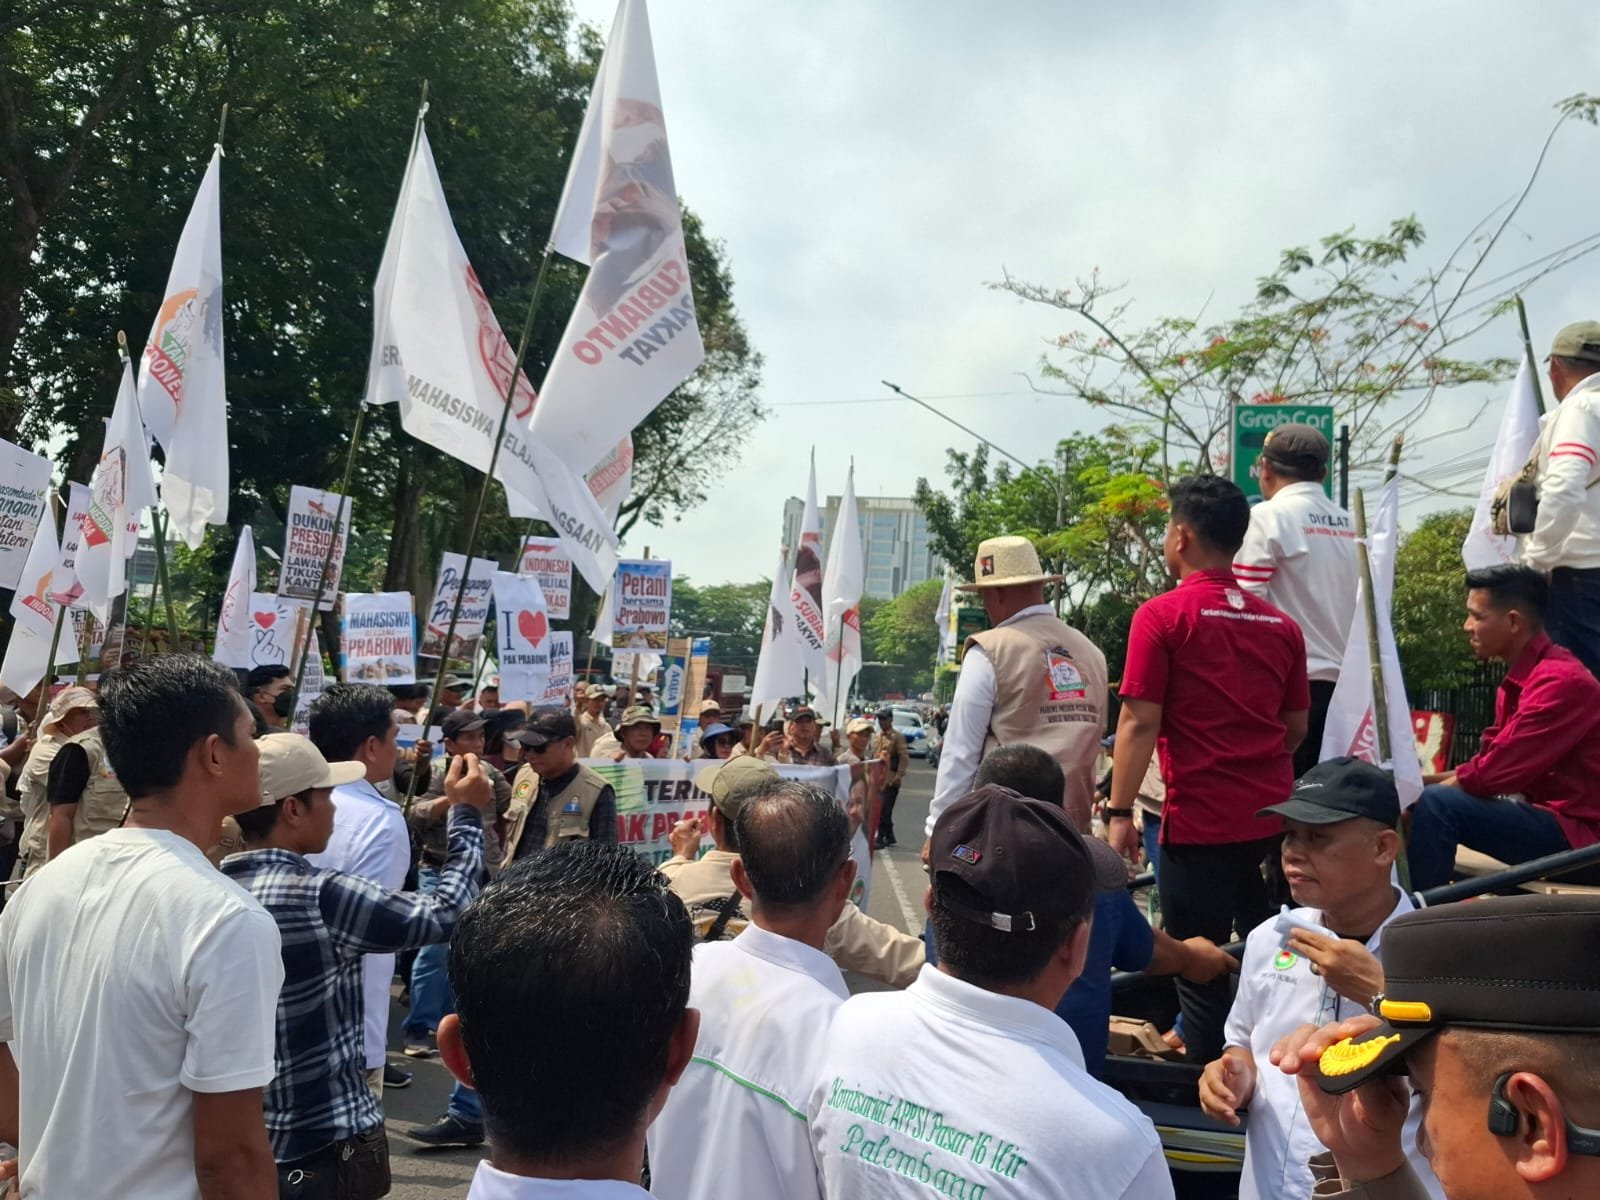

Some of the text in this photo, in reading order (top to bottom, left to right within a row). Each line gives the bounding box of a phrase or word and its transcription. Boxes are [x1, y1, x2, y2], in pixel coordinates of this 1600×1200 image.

[407, 375, 495, 437] MAHASISWA
[1239, 409, 1330, 428] GrabCar
[293, 513, 345, 534] DUKUNG
[291, 527, 343, 550] PRESIDN
[285, 541, 342, 560] PRABOO
[287, 555, 327, 569] LAWAN
[525, 557, 569, 574] INDONESIA
[286, 566, 322, 579] TIKUS
[284, 575, 334, 591] KANTR
[622, 572, 667, 597] Petani
[350, 610, 410, 629] MAHASISWA
[616, 607, 665, 626] Prabowo
[501, 610, 516, 651] I
[503, 654, 518, 664] PAK
[827, 1076, 898, 1125] Komisariat
[889, 1098, 930, 1140] APPSI
[925, 1111, 974, 1157] Pasar
[969, 1131, 993, 1165] 16
[840, 1123, 989, 1200] Palembang
